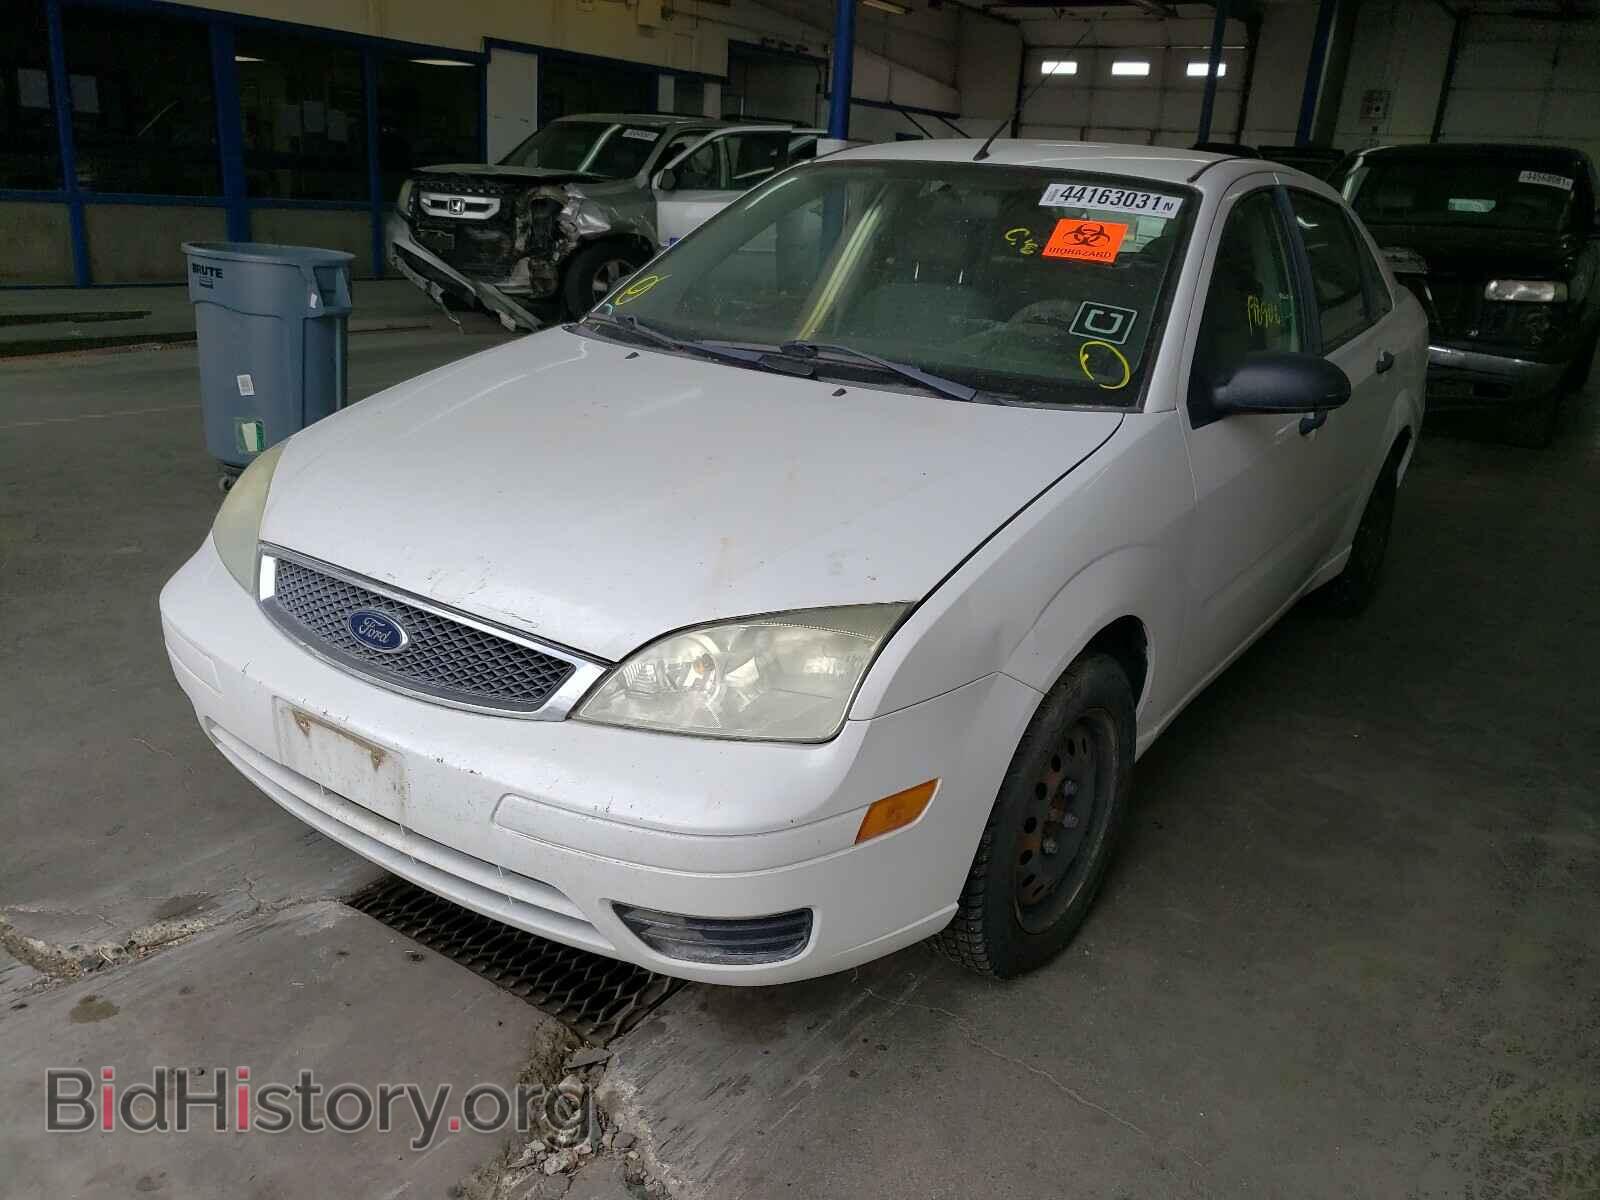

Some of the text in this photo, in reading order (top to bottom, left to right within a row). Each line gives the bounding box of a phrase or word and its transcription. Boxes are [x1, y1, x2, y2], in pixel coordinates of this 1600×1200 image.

[1060, 185, 1162, 211] 44163031
[1163, 201, 1174, 212] N
[1048, 247, 1112, 259] BIOHAZARD
[192, 262, 224, 279] BRUTE
[359, 617, 393, 643] Ford
